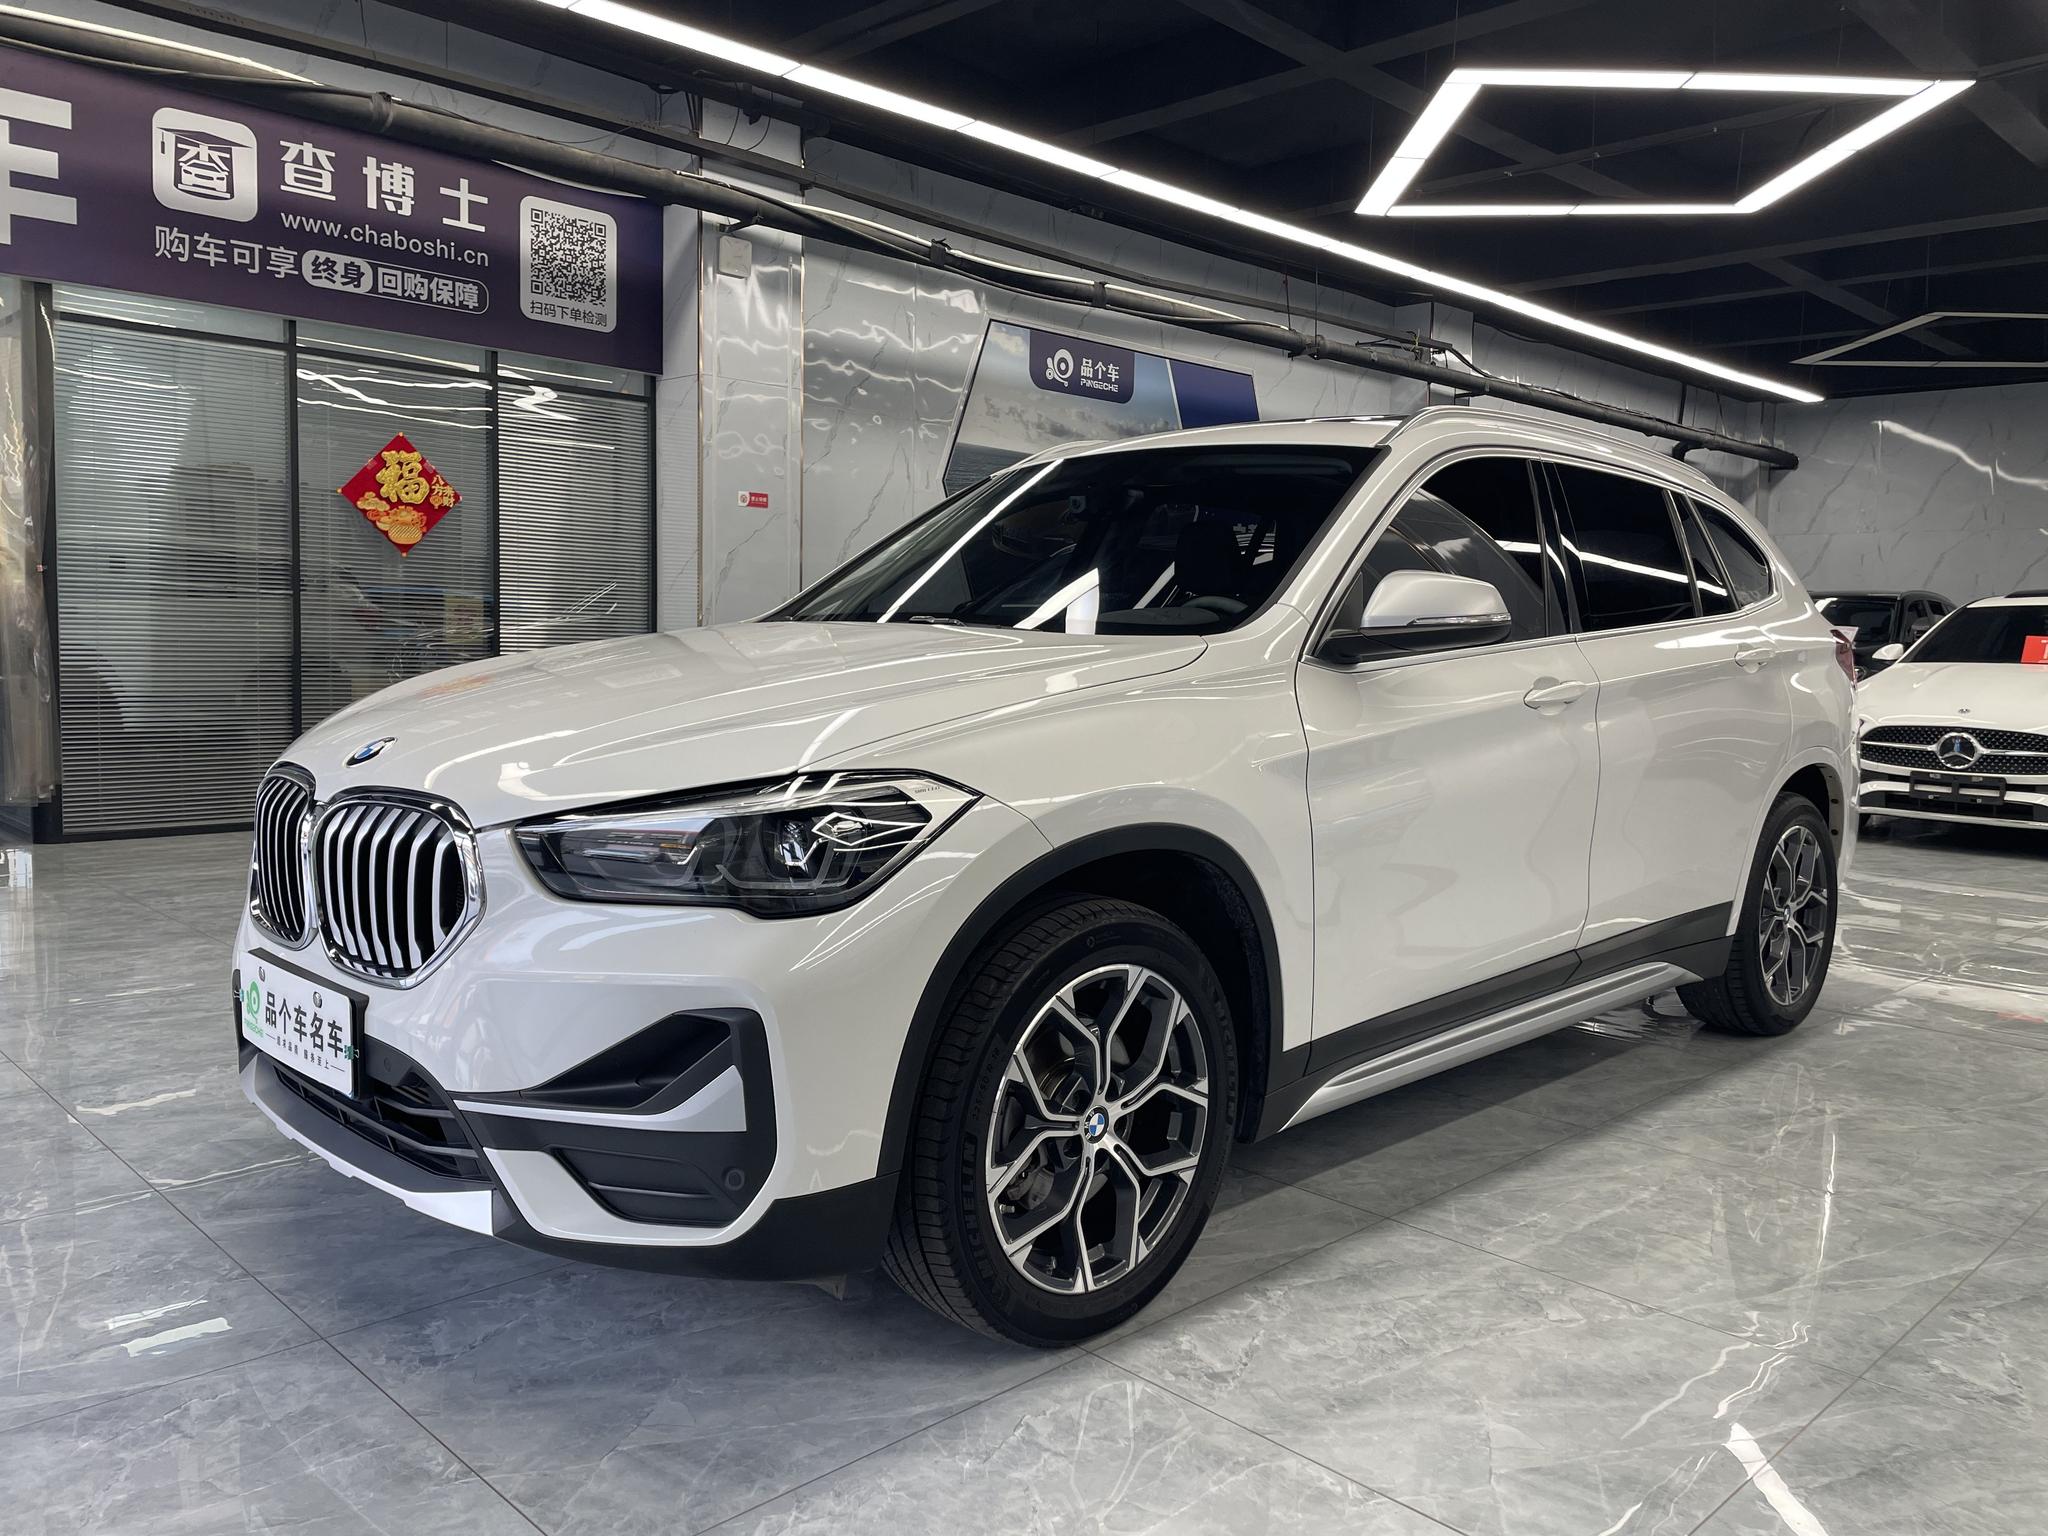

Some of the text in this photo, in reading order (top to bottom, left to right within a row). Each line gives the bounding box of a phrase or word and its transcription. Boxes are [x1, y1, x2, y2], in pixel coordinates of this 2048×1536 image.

[280, 140, 488, 233] 查博士
[281, 212, 489, 267] www.chaboshi.cn
[530, 300, 607, 327] 扫码下单检测
[1081, 358, 1119, 382] 品个车
[376, 450, 430, 504] 福
[265, 991, 344, 1058] 品个车名车
[961, 1139, 993, 1280] MICHELIN
